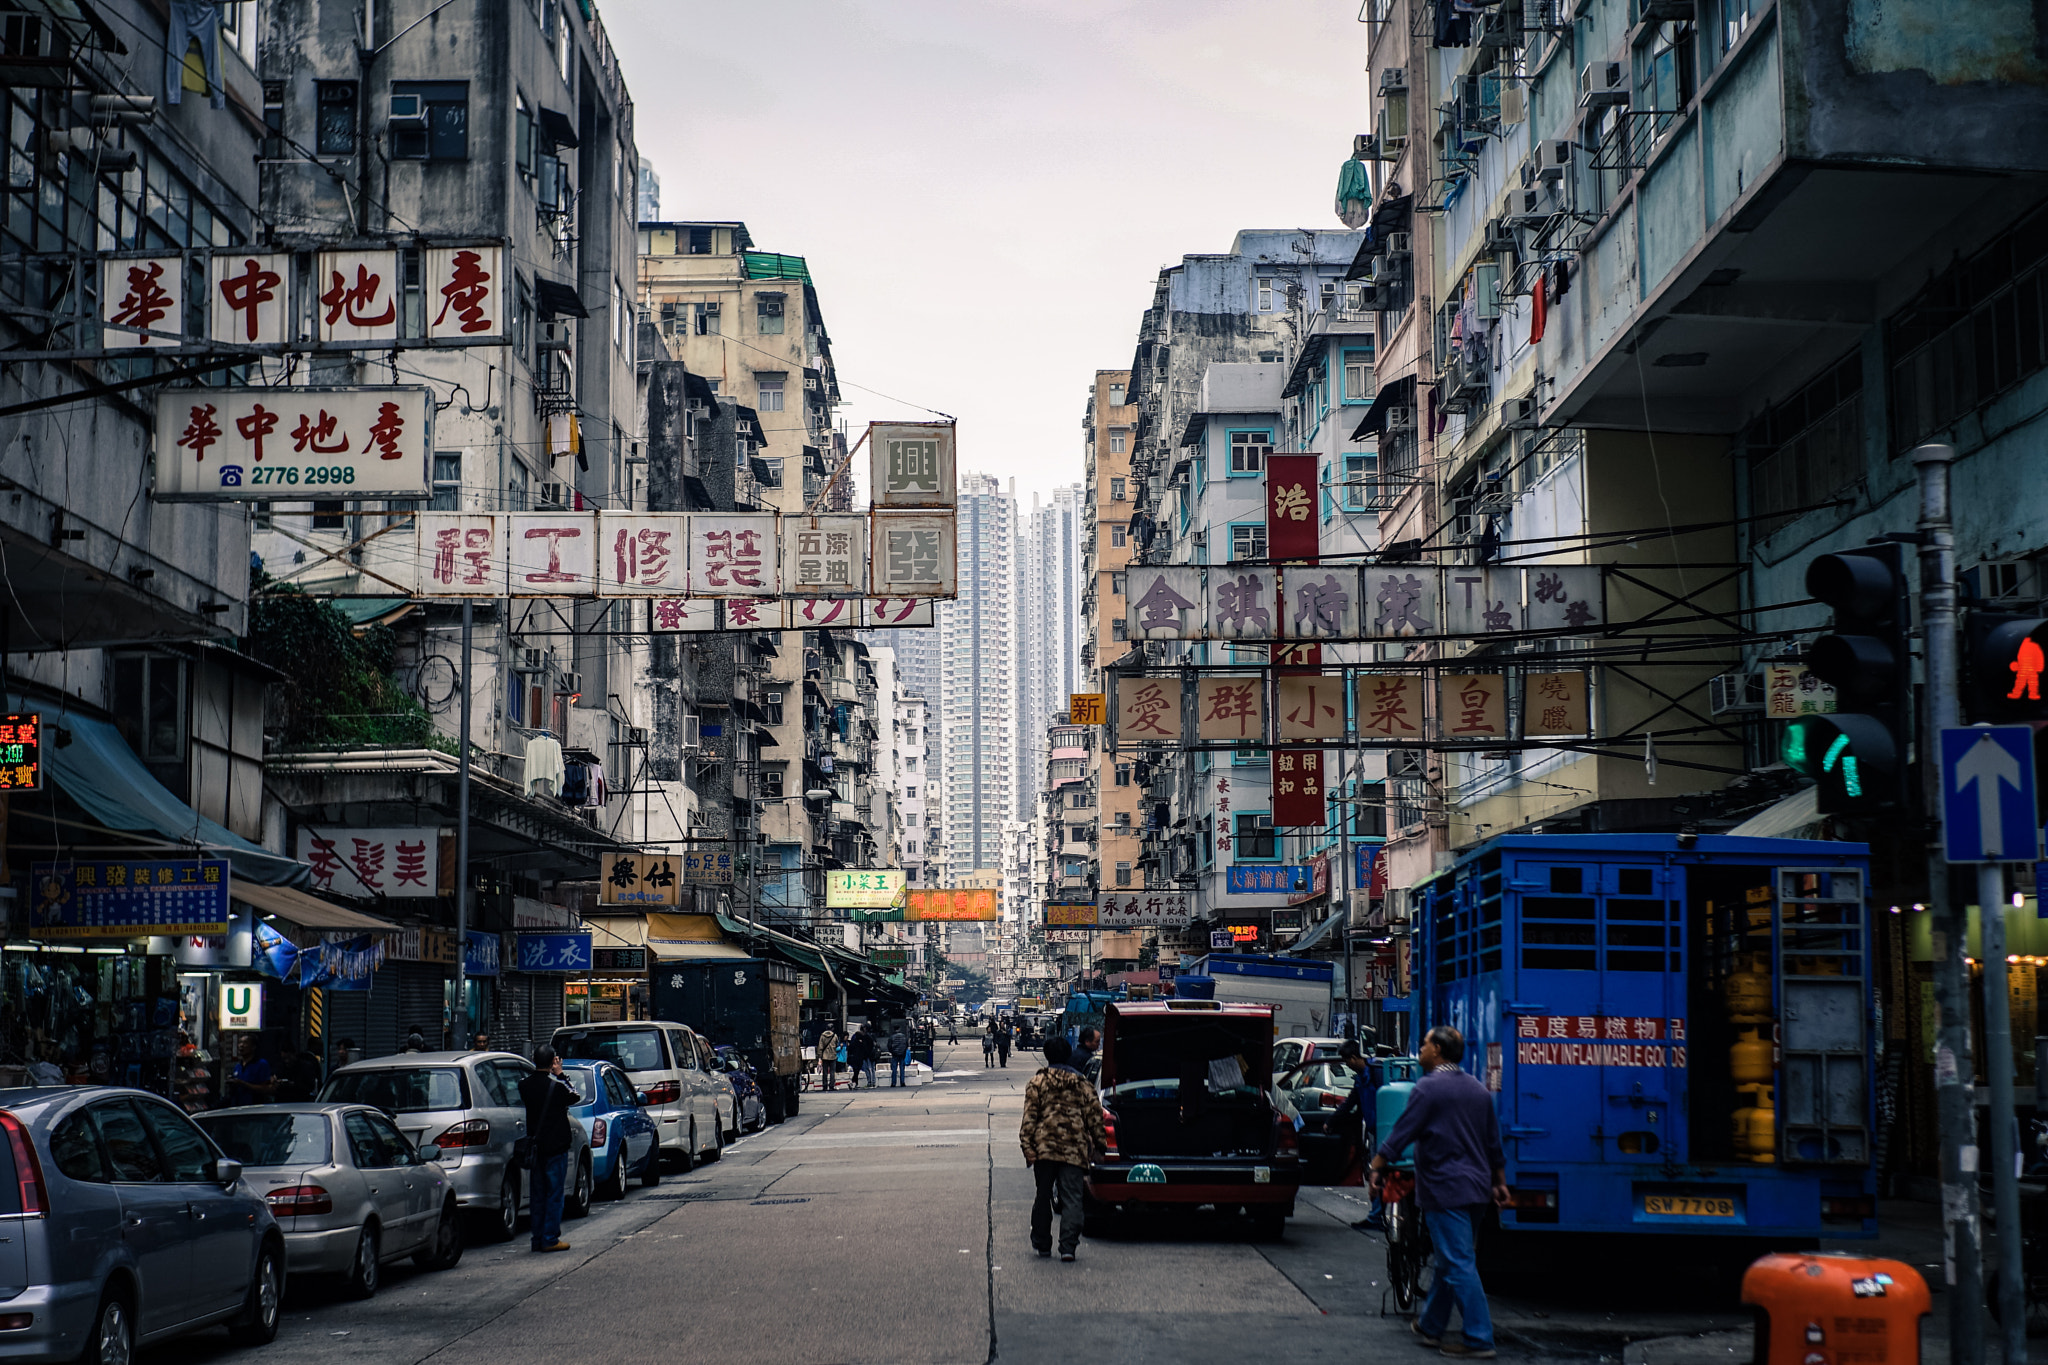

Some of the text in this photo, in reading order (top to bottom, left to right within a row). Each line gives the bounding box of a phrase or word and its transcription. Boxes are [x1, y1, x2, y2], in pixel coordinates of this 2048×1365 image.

[110, 250, 492, 345] 華中地產
[176, 402, 405, 462] 華中地產
[251, 465, 356, 485] 2776 2998
[1072, 695, 1100, 722] 新
[1126, 677, 1495, 735] 愛群小菜皇
[1216, 778, 1232, 852] 豪景賓館
[608, 857, 676, 889] 樂仕
[686, 852, 732, 870] 知足樂
[75, 864, 221, 887] 興發裝修工程
[843, 873, 889, 890] 小菜王
[1231, 869, 1289, 889] 大新辦館
[523, 938, 588, 967] 洗衣
[227, 987, 251, 1015] U
[1517, 1015, 1686, 1041] 高度易燃物品
[1517, 1042, 1561, 1065] HIGHLY
[1561, 1042, 1643, 1067] INFLAMMABLE
[1142, 1168, 1151, 1177] 4
[1650, 1197, 1730, 1214] SW 7708
